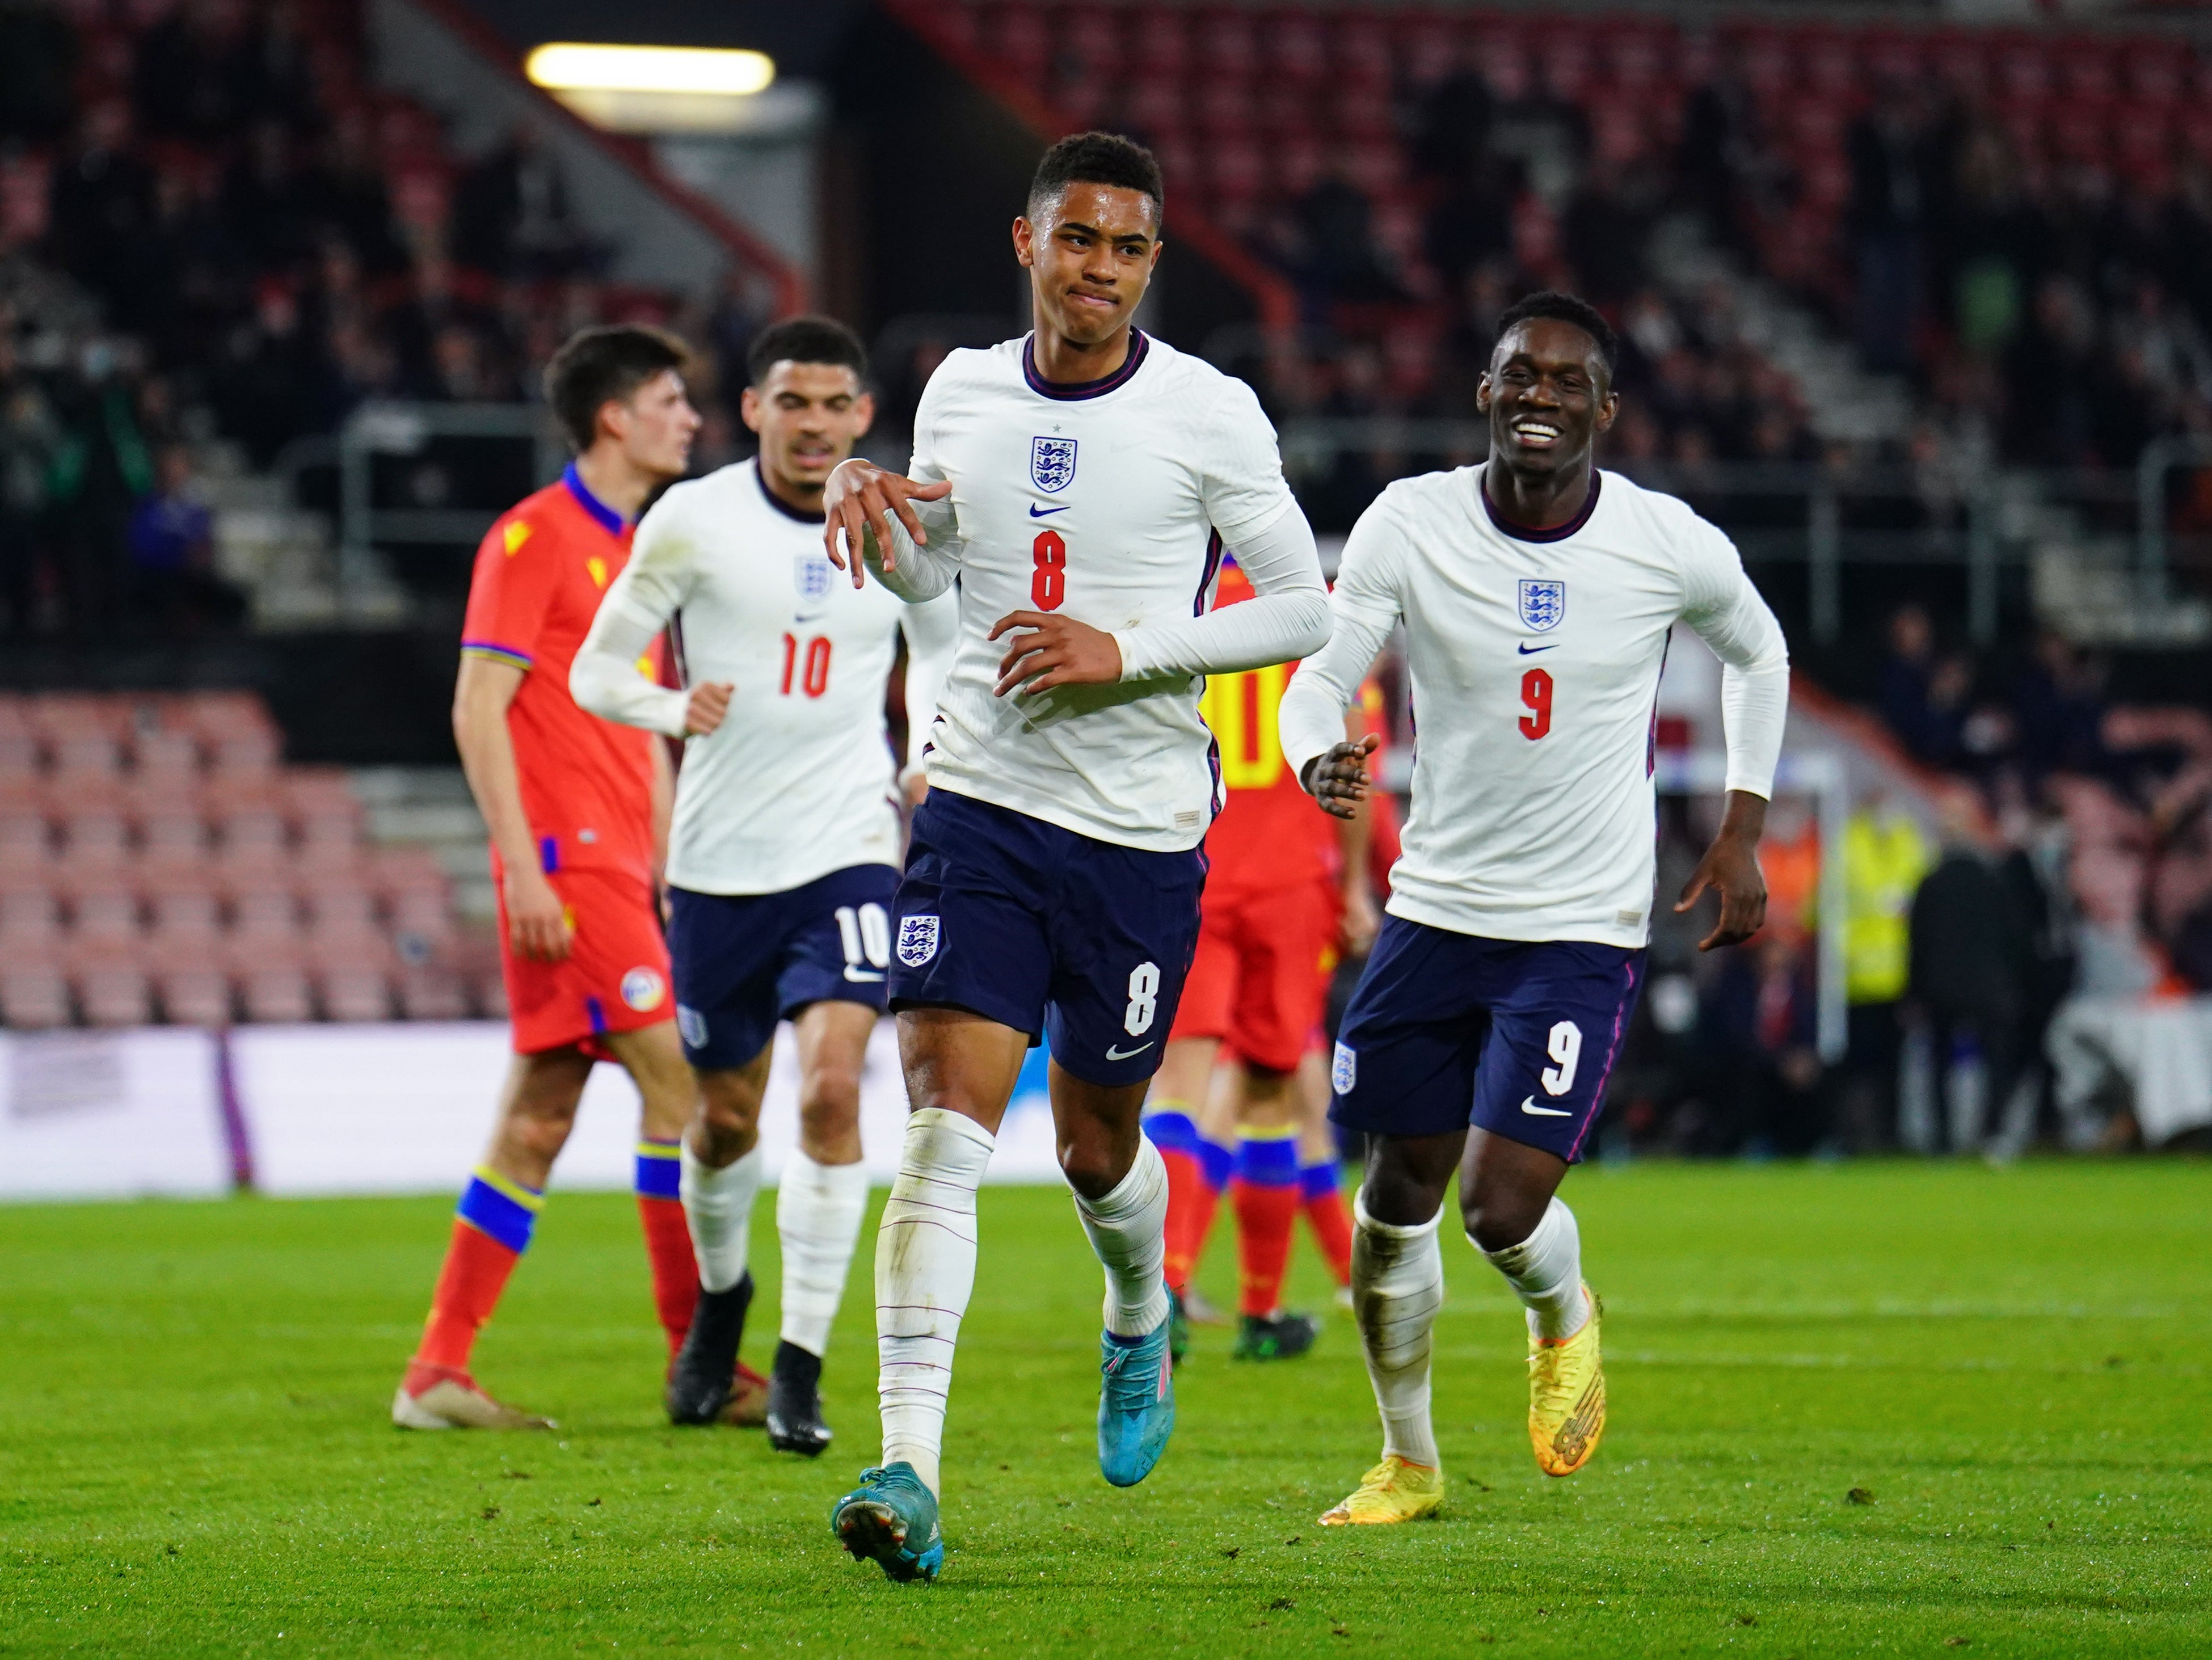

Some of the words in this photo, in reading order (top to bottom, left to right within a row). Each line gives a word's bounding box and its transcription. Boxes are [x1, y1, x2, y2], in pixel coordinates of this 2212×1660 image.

[1031, 530, 1066, 612] 8
[780, 631, 832, 698] 10
[1518, 668, 1553, 740] 9
[835, 902, 890, 968] 10
[1123, 962, 1161, 1037] 8
[1541, 1021, 1582, 1096] 9
